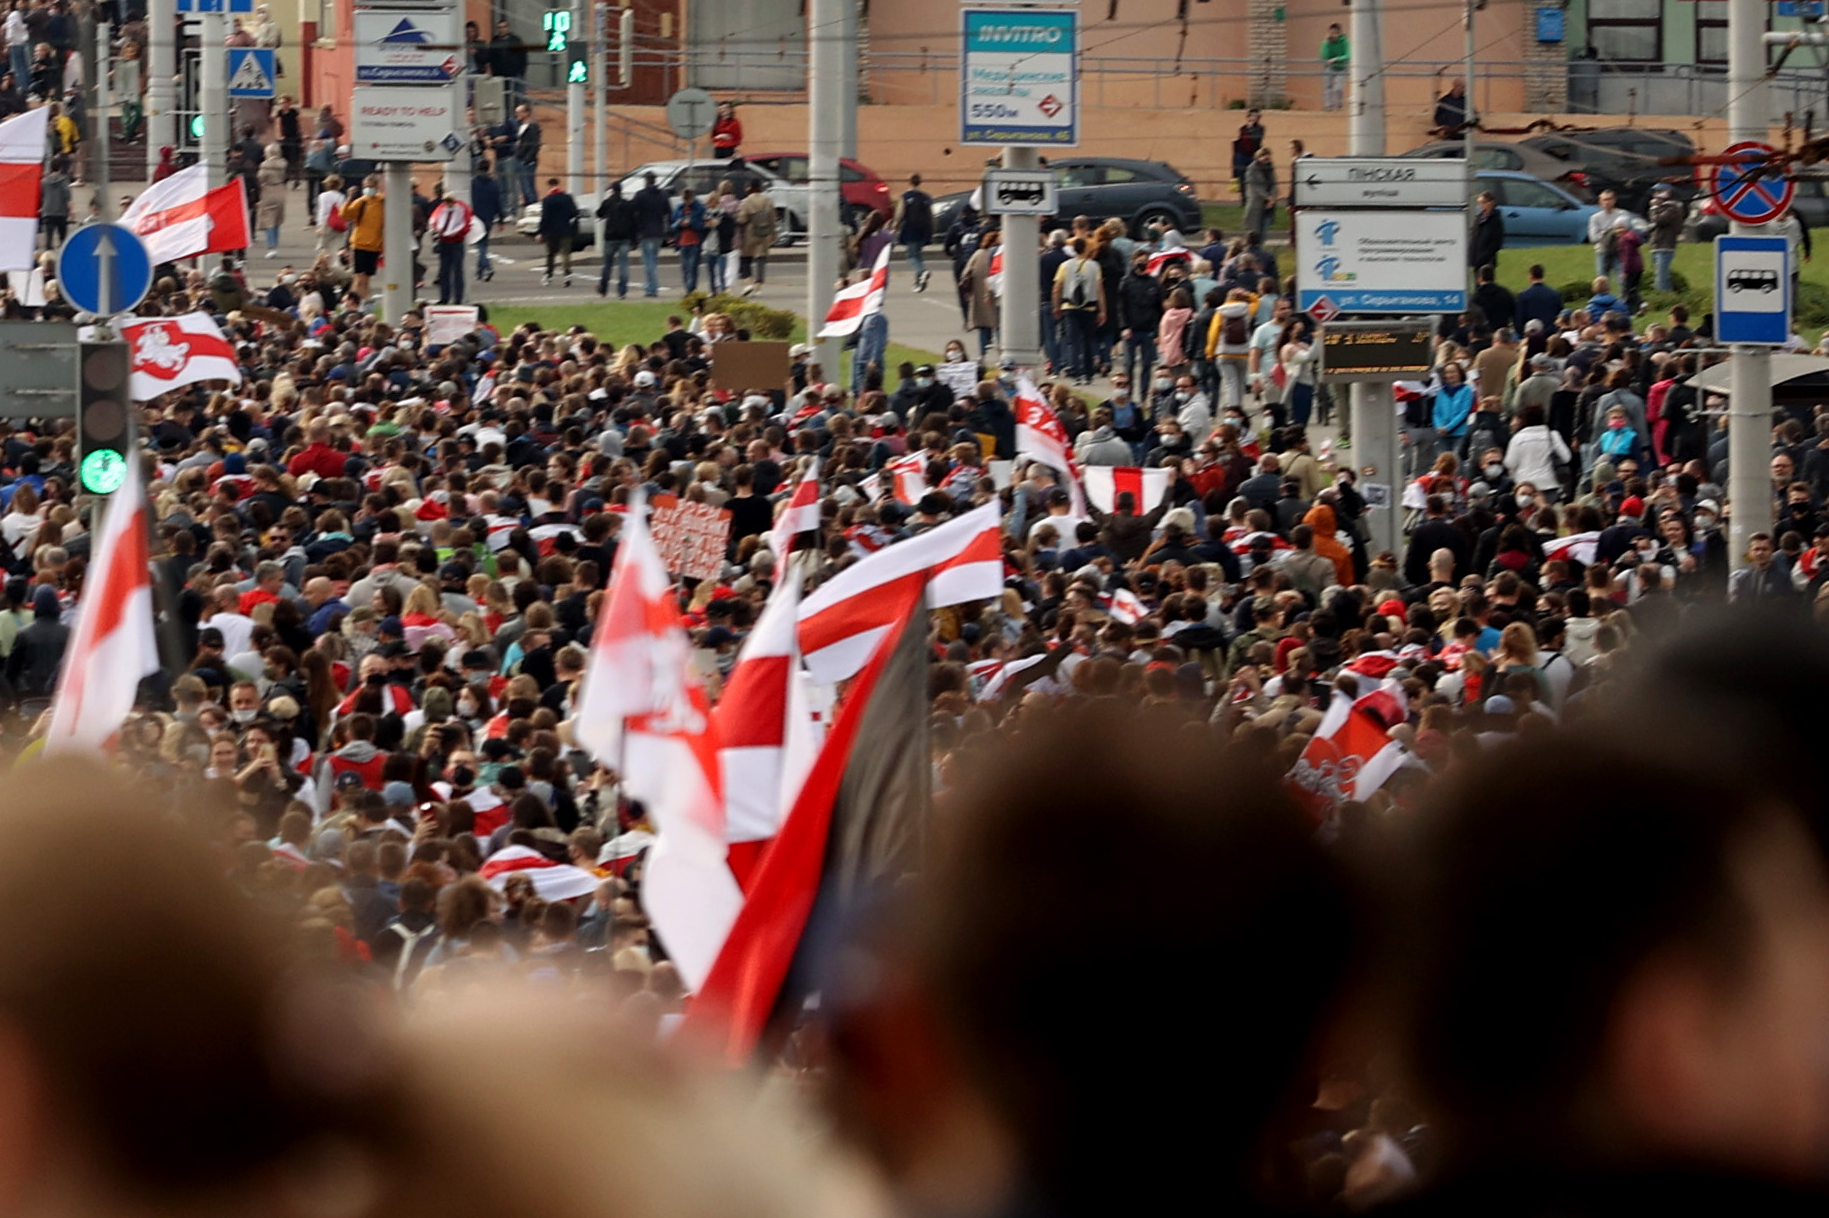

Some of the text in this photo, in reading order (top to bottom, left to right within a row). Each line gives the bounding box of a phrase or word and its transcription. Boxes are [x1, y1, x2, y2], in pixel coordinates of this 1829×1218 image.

[543, 11, 571, 32] 10
[977, 24, 1062, 44] INVITRO
[973, 67, 1067, 81] Медицинские
[361, 106, 448, 118] READY TO HELP
[1347, 167, 1416, 182] ПІНСКАЯ
[1338, 295, 1358, 307] ул.
[1445, 295, 1460, 306] 14
